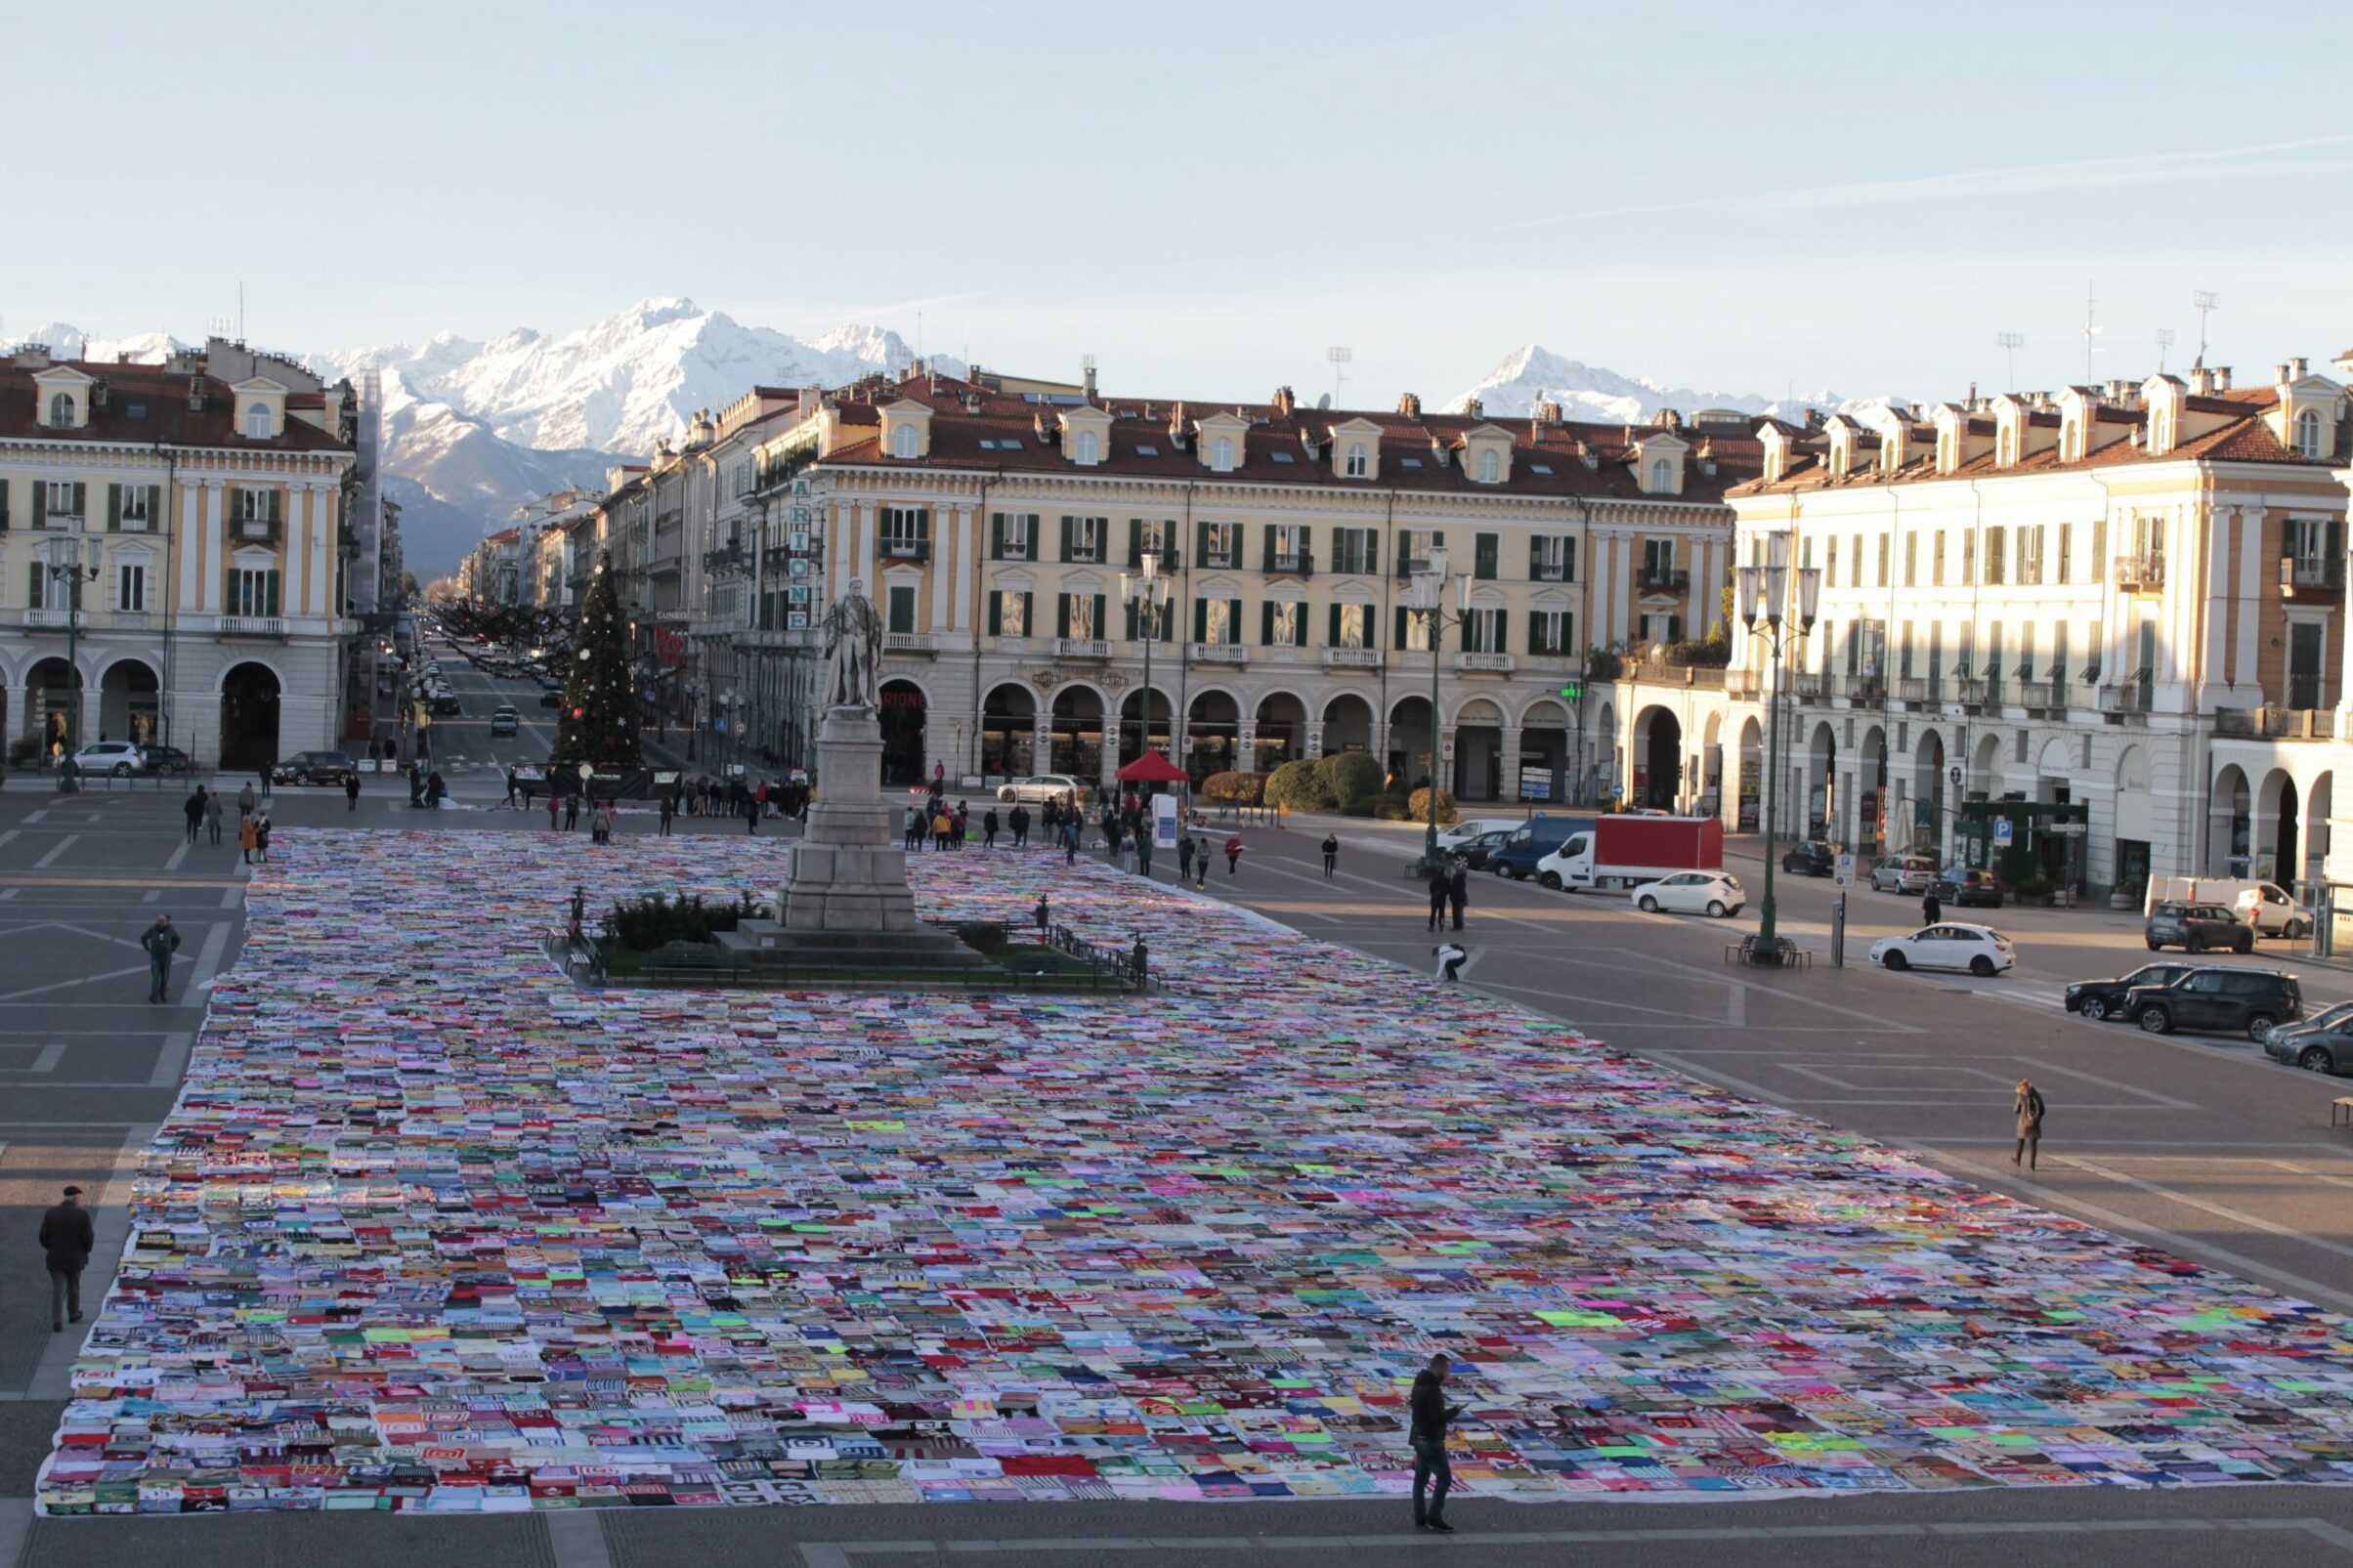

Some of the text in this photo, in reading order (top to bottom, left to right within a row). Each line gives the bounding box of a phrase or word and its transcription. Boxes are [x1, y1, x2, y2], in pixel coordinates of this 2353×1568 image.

[791, 480, 810, 628] ARIONE
[1033, 673, 1061, 684] MARTINI
[1101, 675, 1129, 686] MARTINI
[1998, 823, 2009, 835] P
